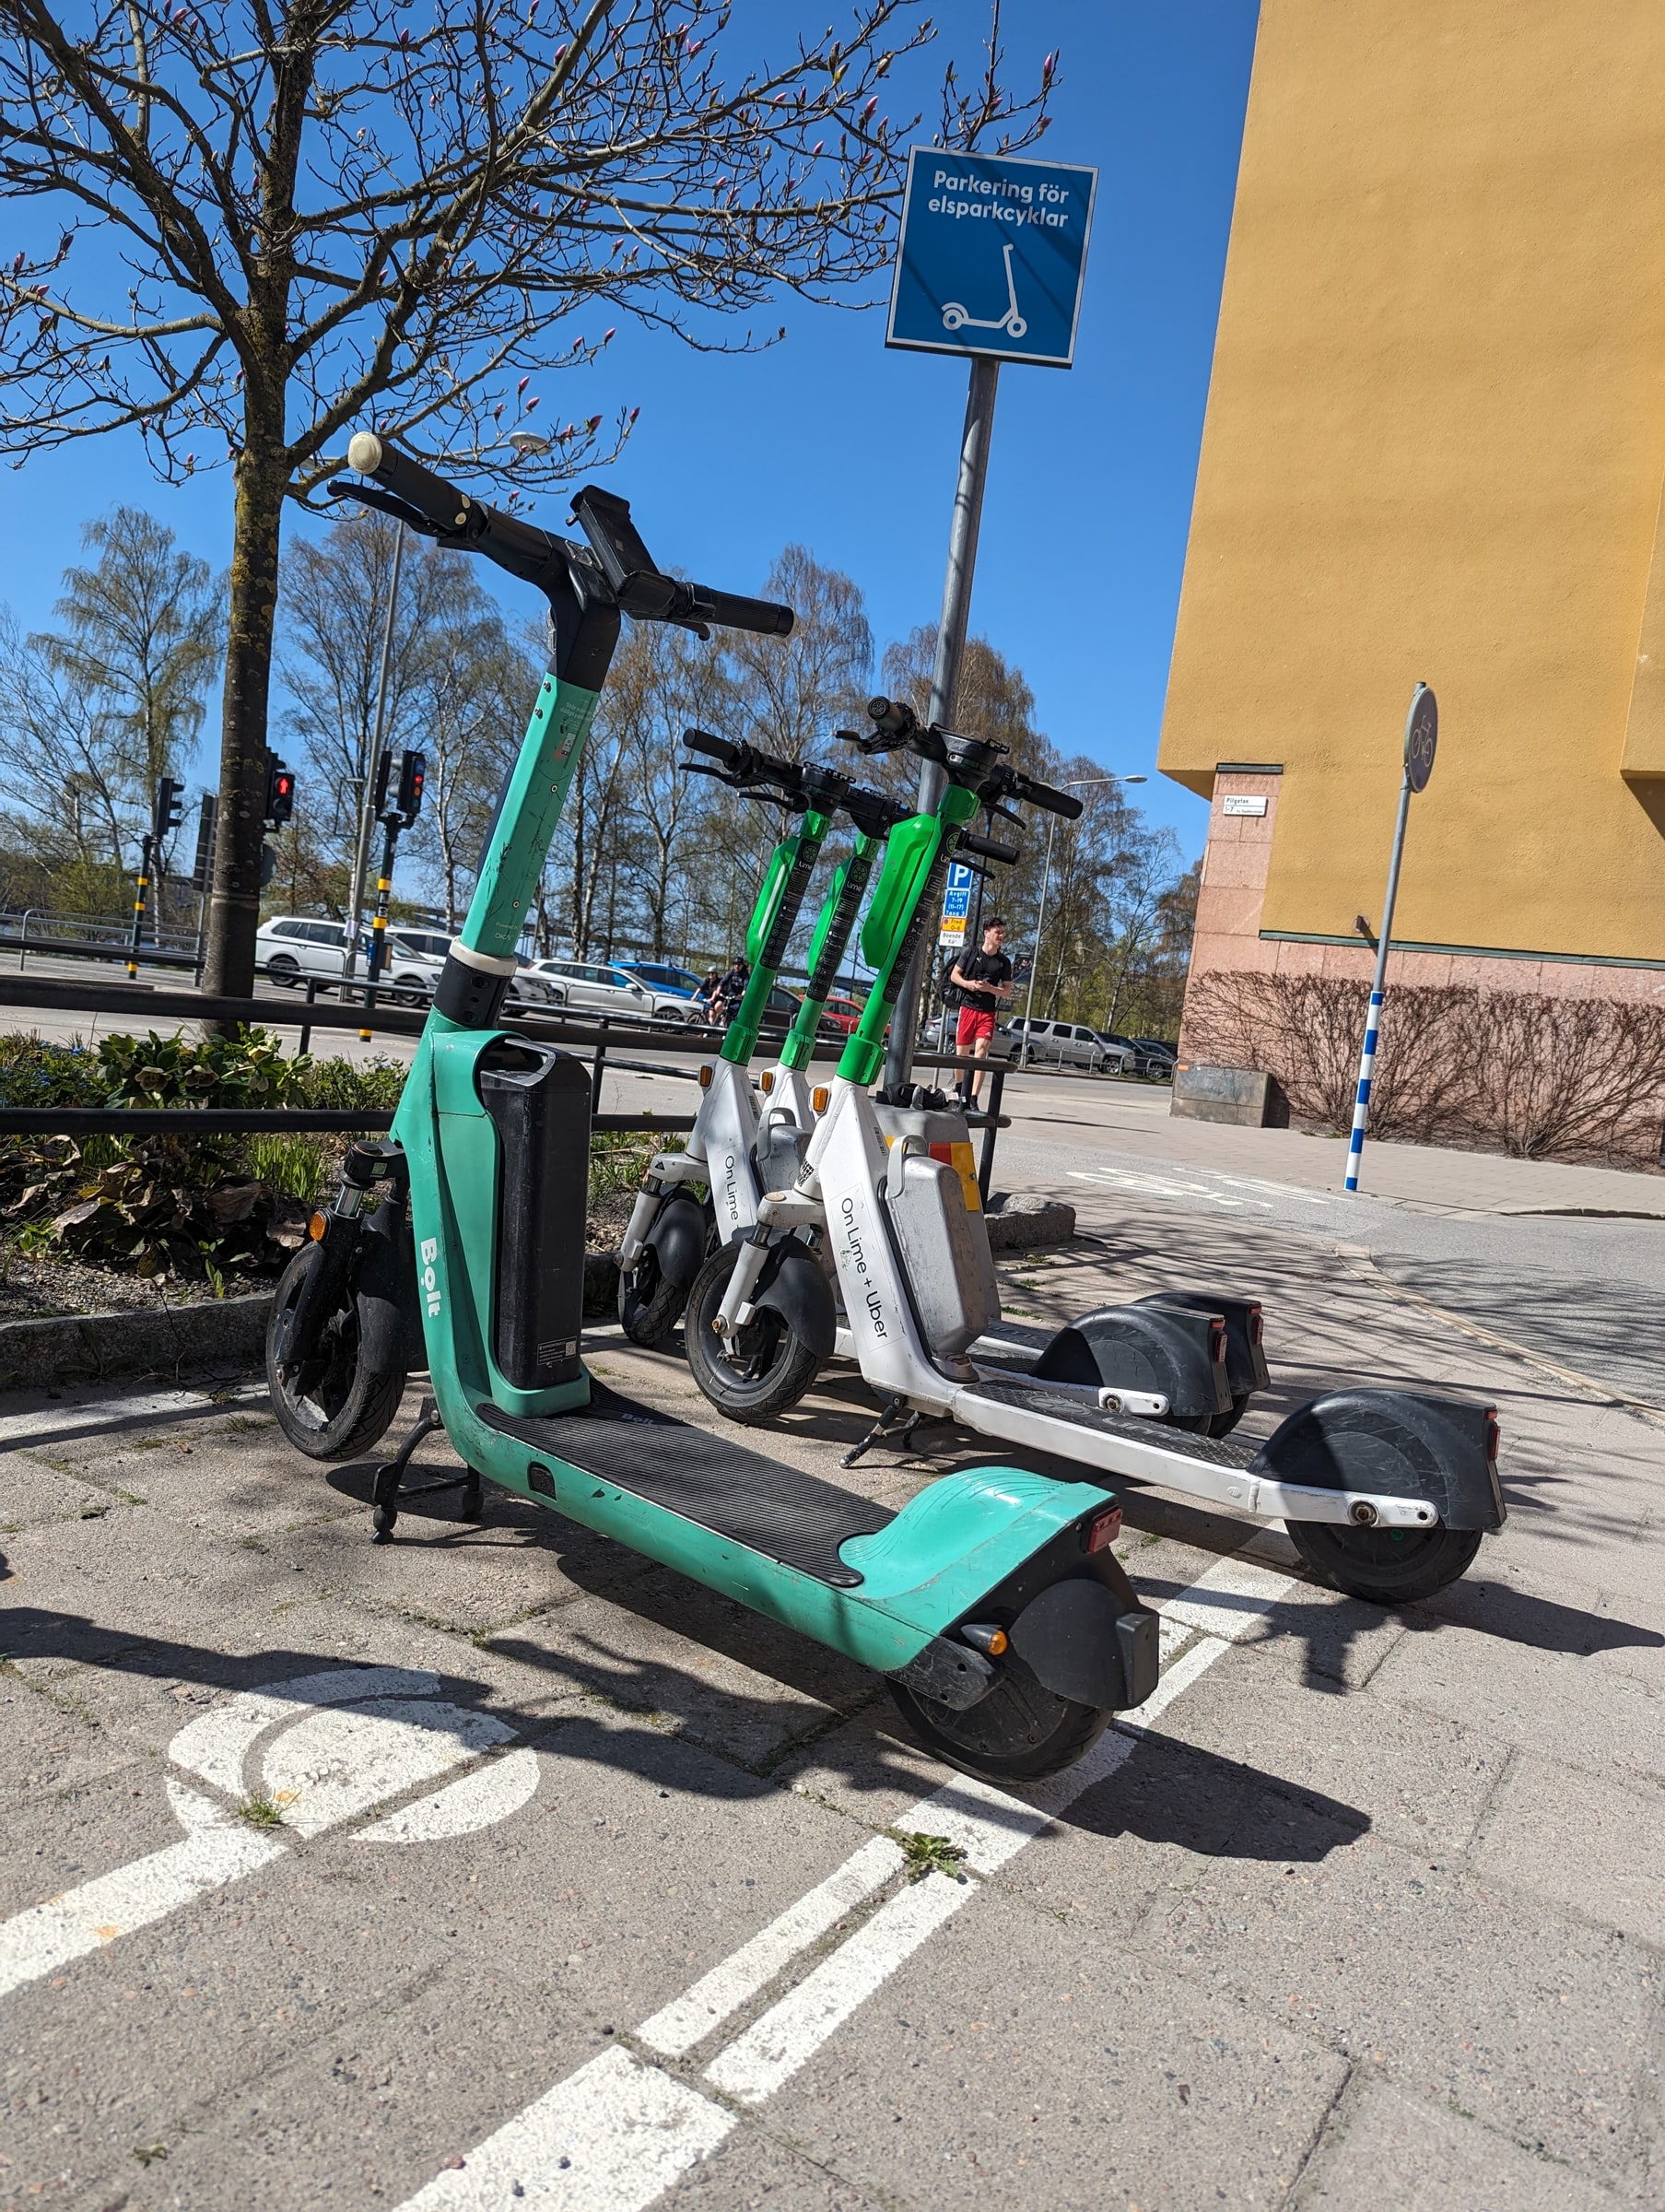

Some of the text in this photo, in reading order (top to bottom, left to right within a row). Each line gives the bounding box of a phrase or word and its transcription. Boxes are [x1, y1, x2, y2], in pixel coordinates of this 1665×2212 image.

[933, 170, 1070, 205] Parkering för
[928, 195, 1069, 228] elsparkcyklar
[954, 865, 969, 887] P
[949, 890, 967, 899] Avgift
[724, 1155, 739, 1221] On Lime
[841, 1197, 854, 1227] On
[847, 1227, 867, 1274] Lime
[420, 1237, 441, 1318] Bolt
[866, 1290, 888, 1338] Uber
